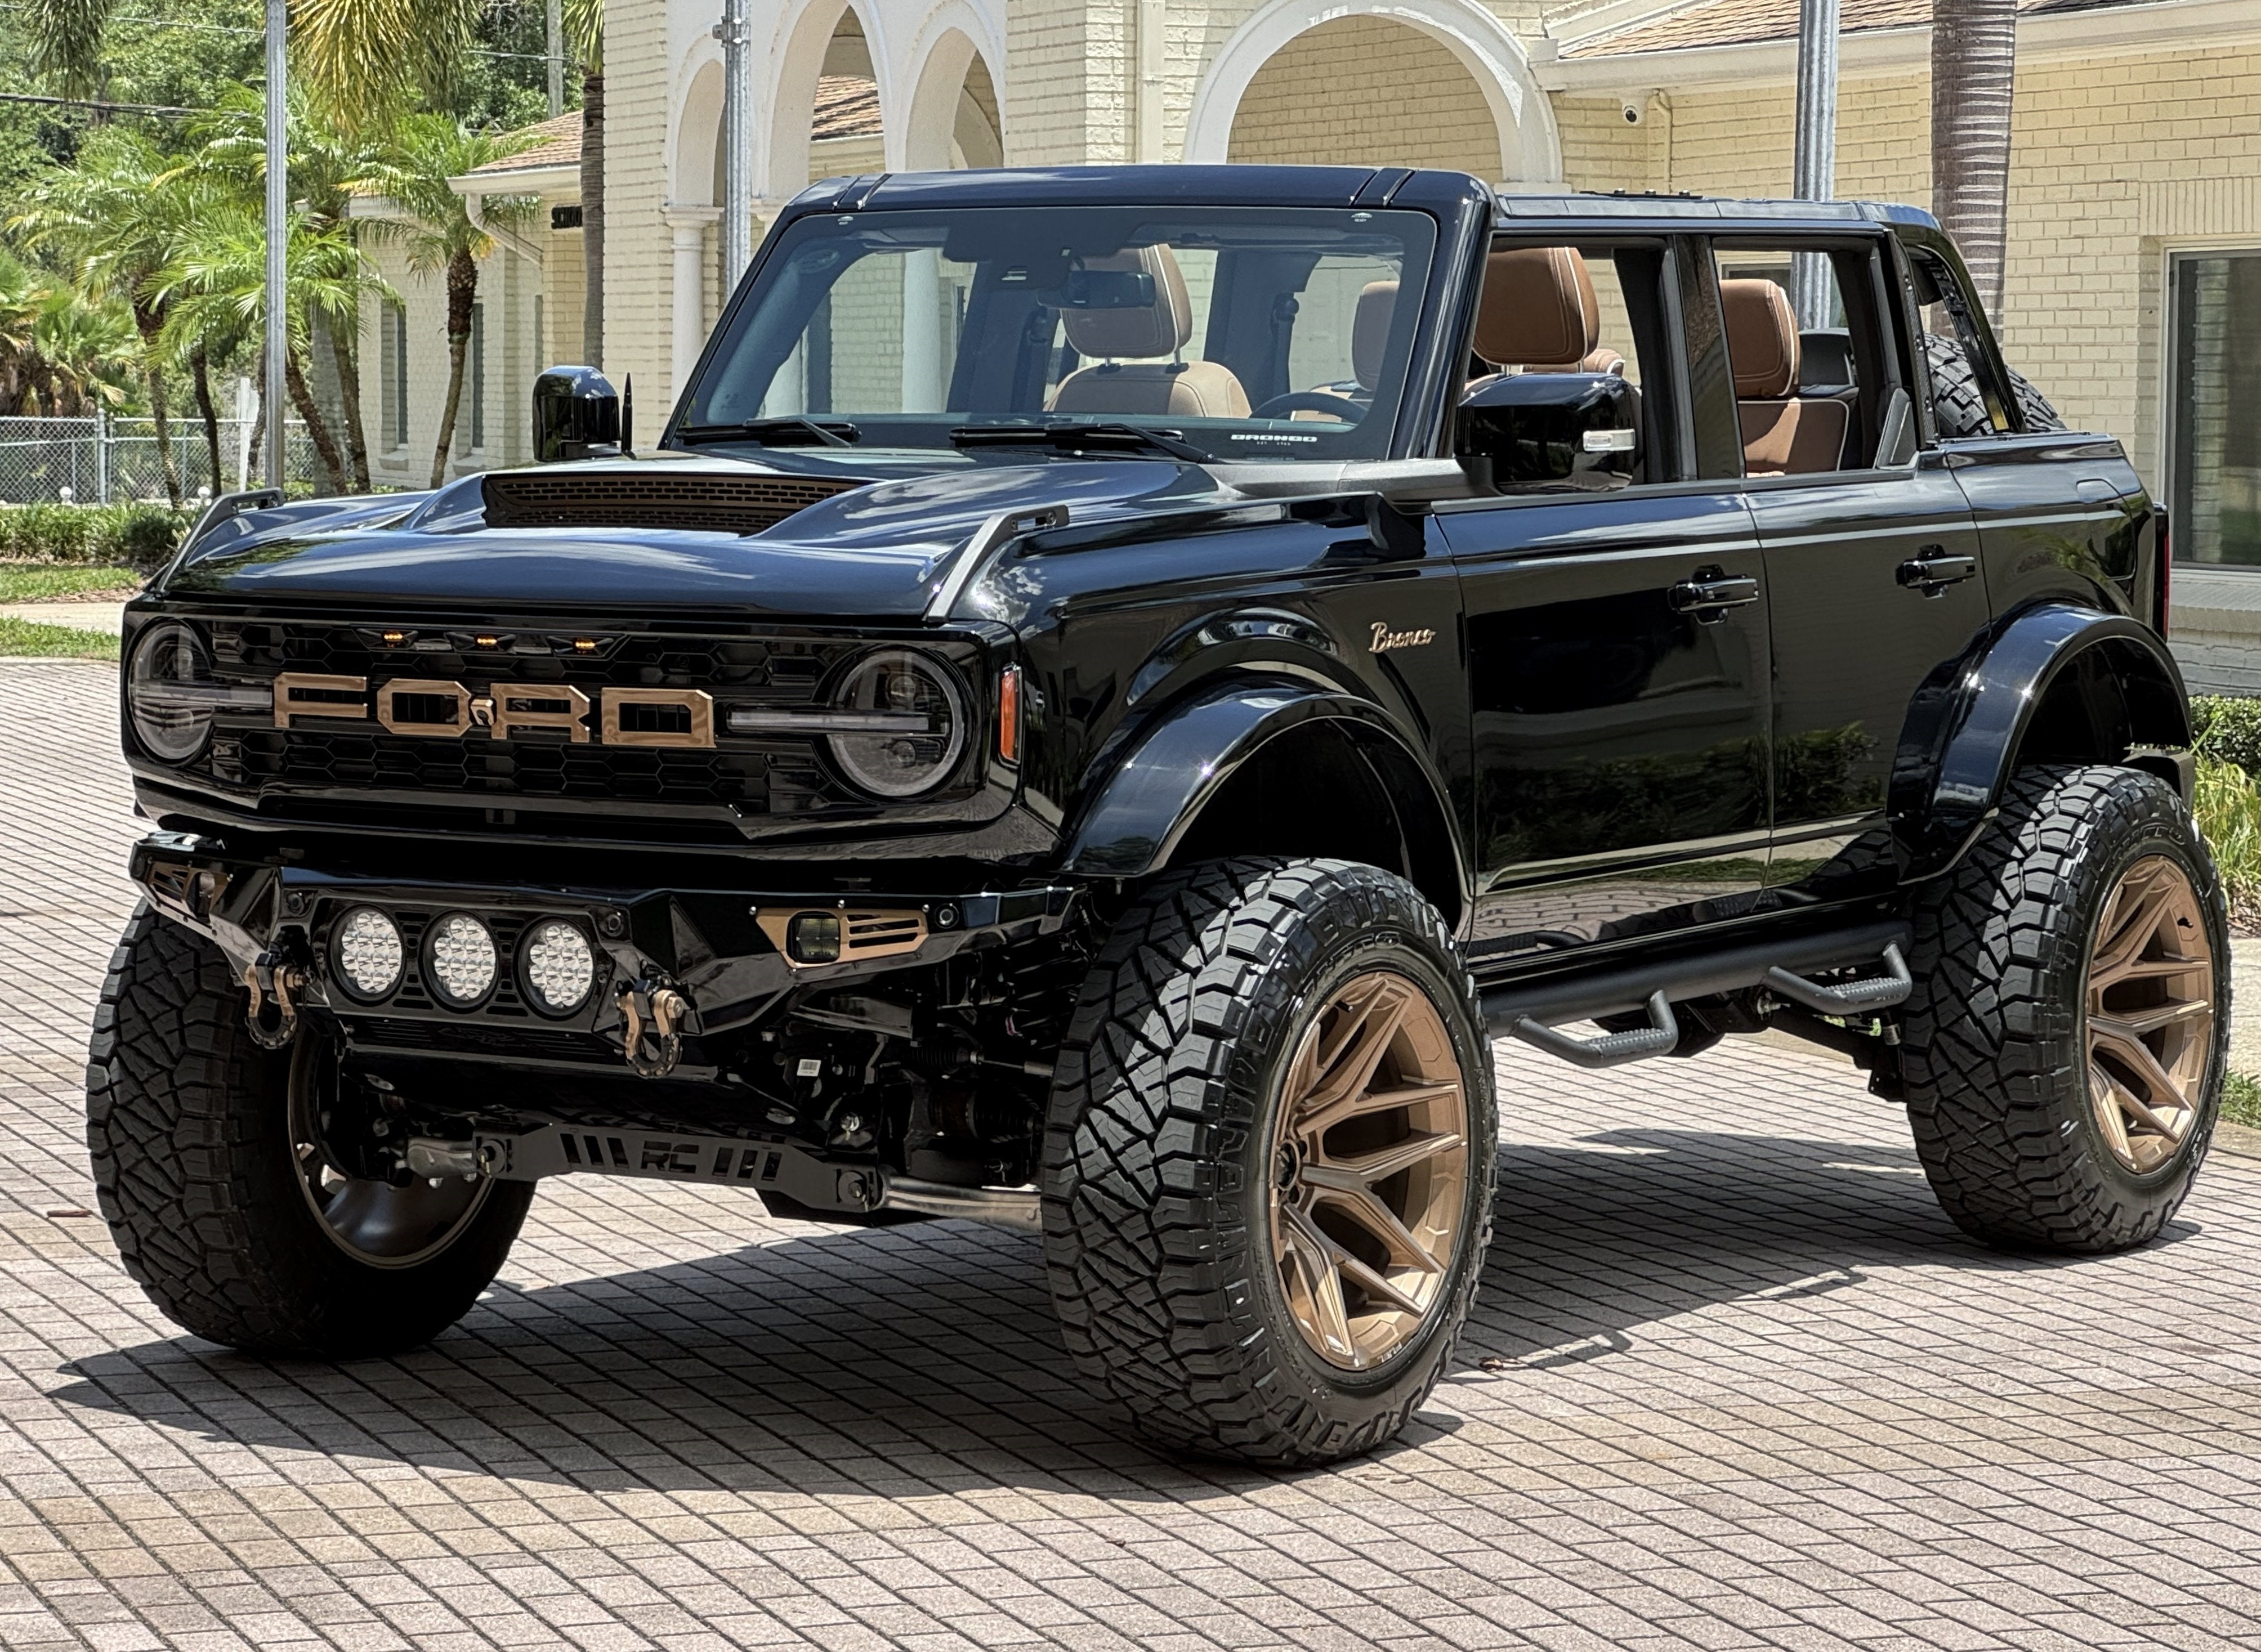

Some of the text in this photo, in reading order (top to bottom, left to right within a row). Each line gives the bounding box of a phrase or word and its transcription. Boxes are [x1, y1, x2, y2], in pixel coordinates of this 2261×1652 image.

[551, 207, 583, 229] SCHOO
[1369, 622, 1436, 653] Bronco
[274, 672, 717, 747] FORD
[641, 1140, 699, 1173] RC
